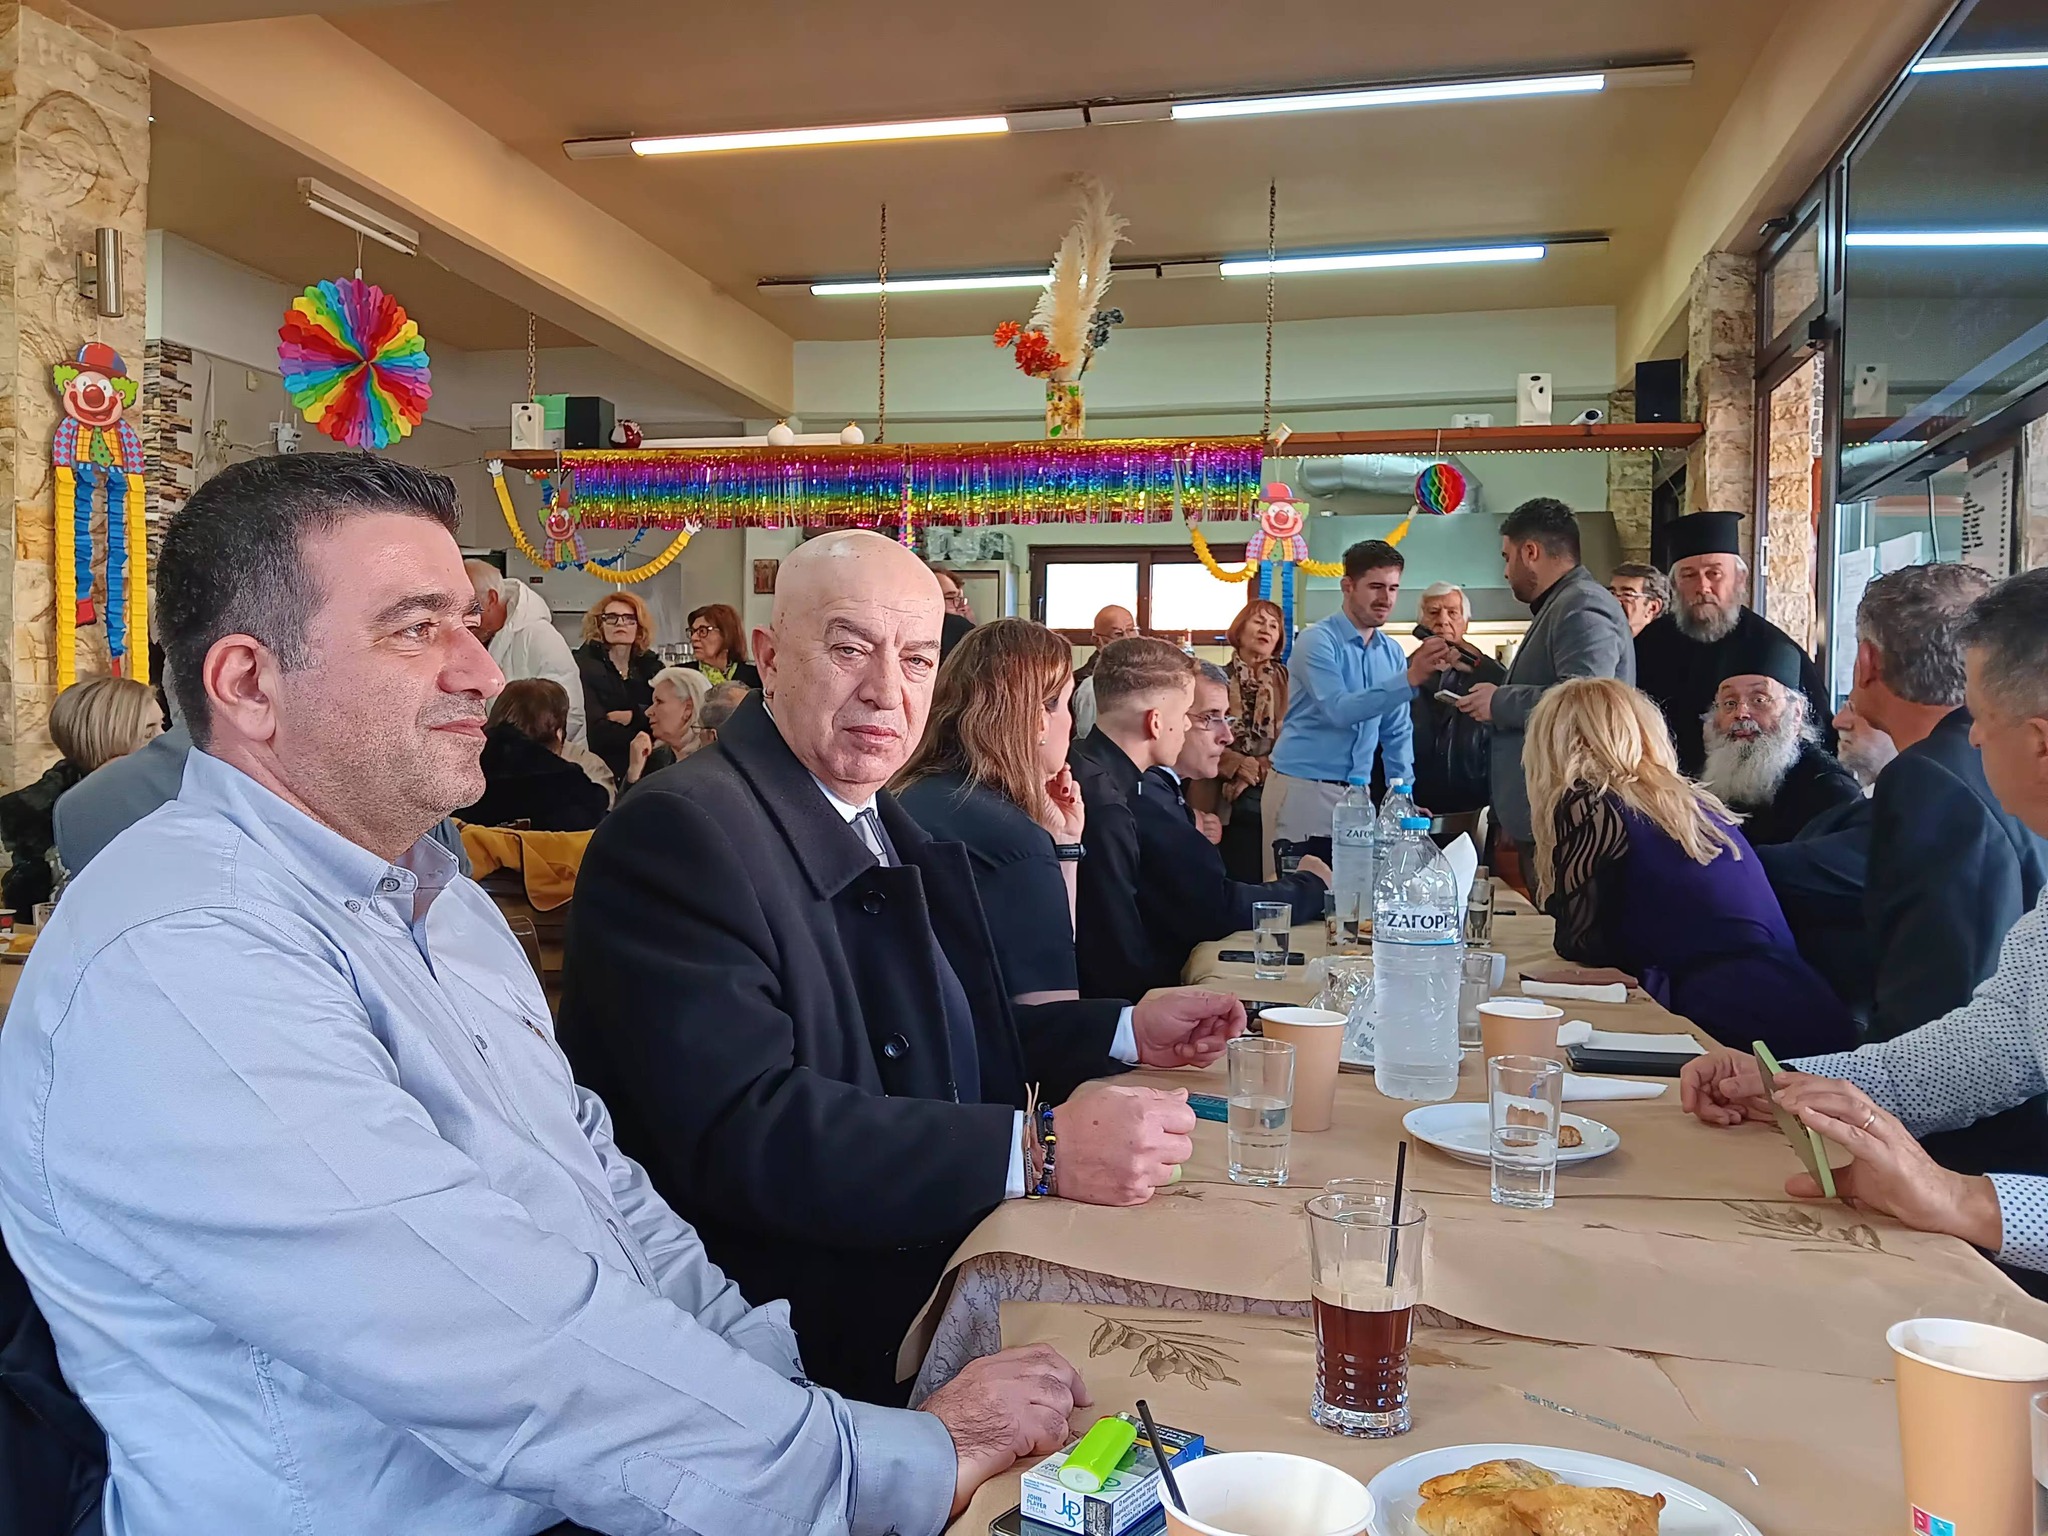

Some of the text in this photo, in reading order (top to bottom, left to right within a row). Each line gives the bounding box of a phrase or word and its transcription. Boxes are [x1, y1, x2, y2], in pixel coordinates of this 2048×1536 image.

[1027, 1493, 1042, 1502] JOHN
[1026, 1498, 1047, 1510] PLAYER
[1026, 1504, 1047, 1516] SPECIAL
